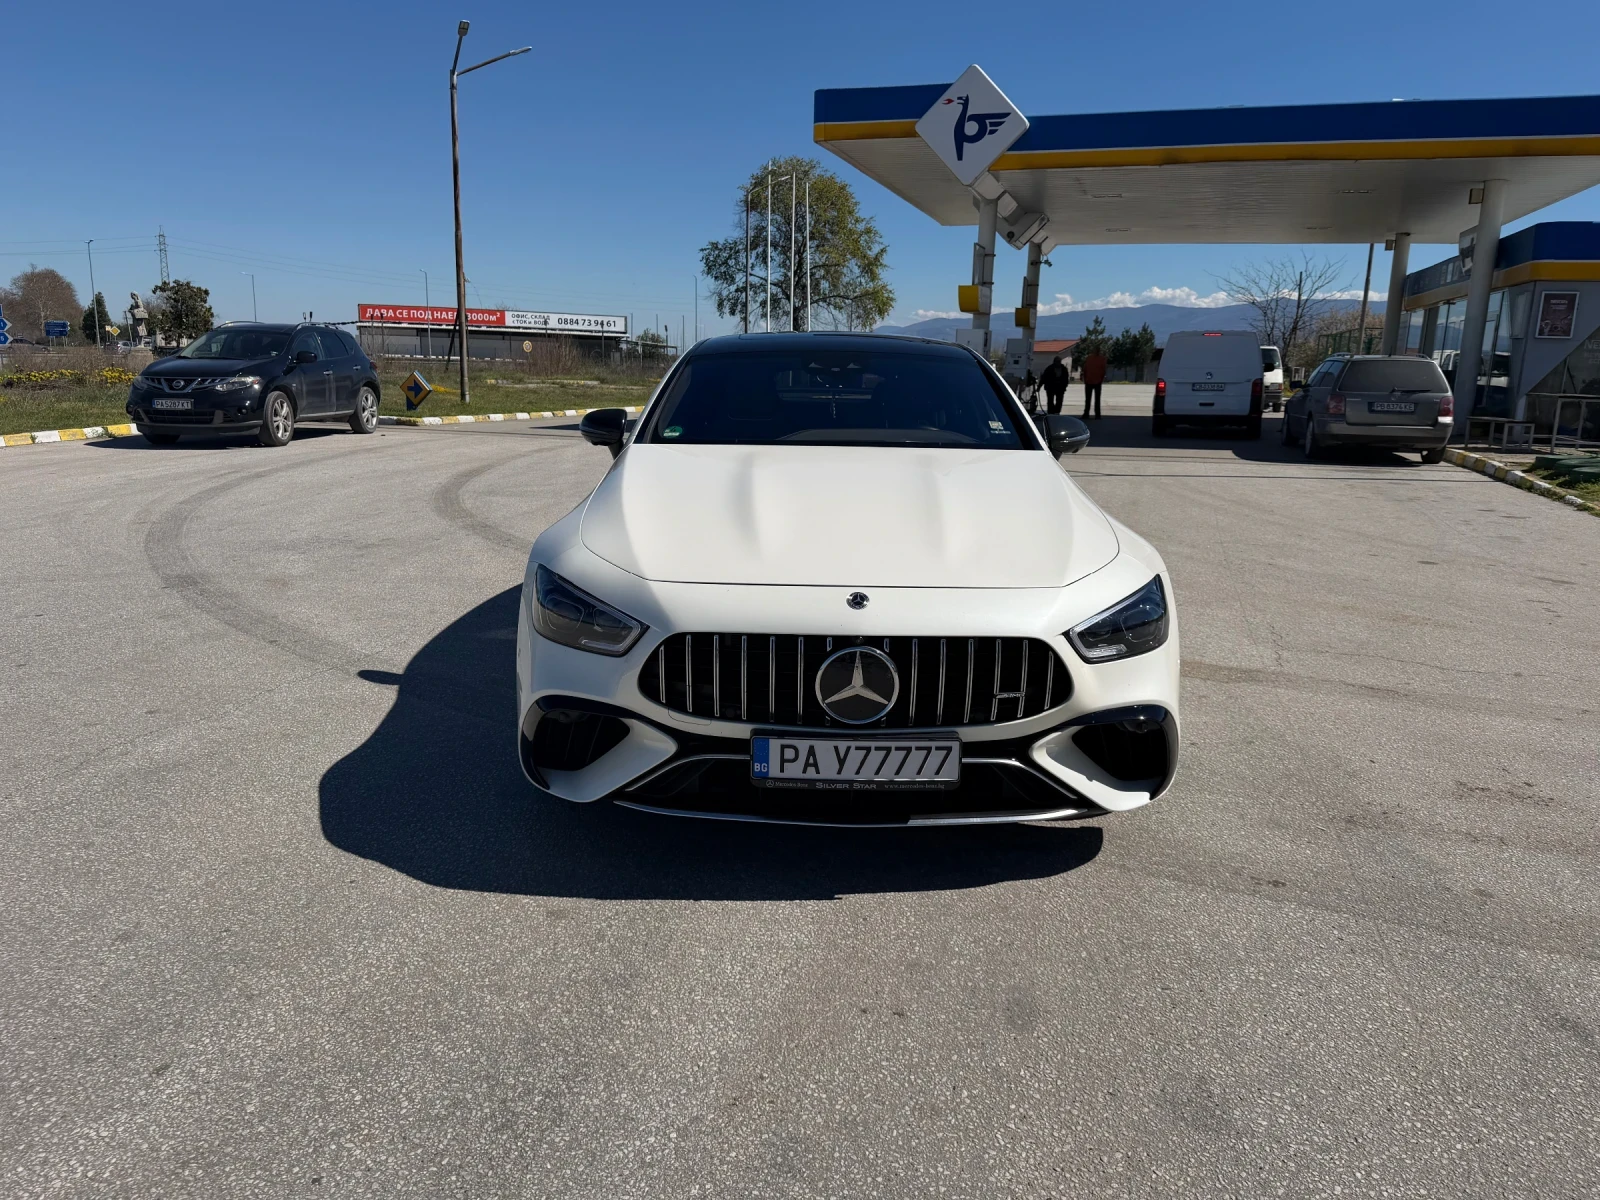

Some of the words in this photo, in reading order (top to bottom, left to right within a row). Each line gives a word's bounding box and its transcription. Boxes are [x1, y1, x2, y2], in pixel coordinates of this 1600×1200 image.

[366, 308, 395, 318] ДАВА
[396, 309, 409, 318] СЕ
[410, 310, 433, 320] ПОД
[557, 318, 579, 326] 0884
[581, 319, 592, 327] 73
[606, 320, 616, 328] 61
[779, 744, 821, 775] PA
[754, 763, 768, 772] BG
